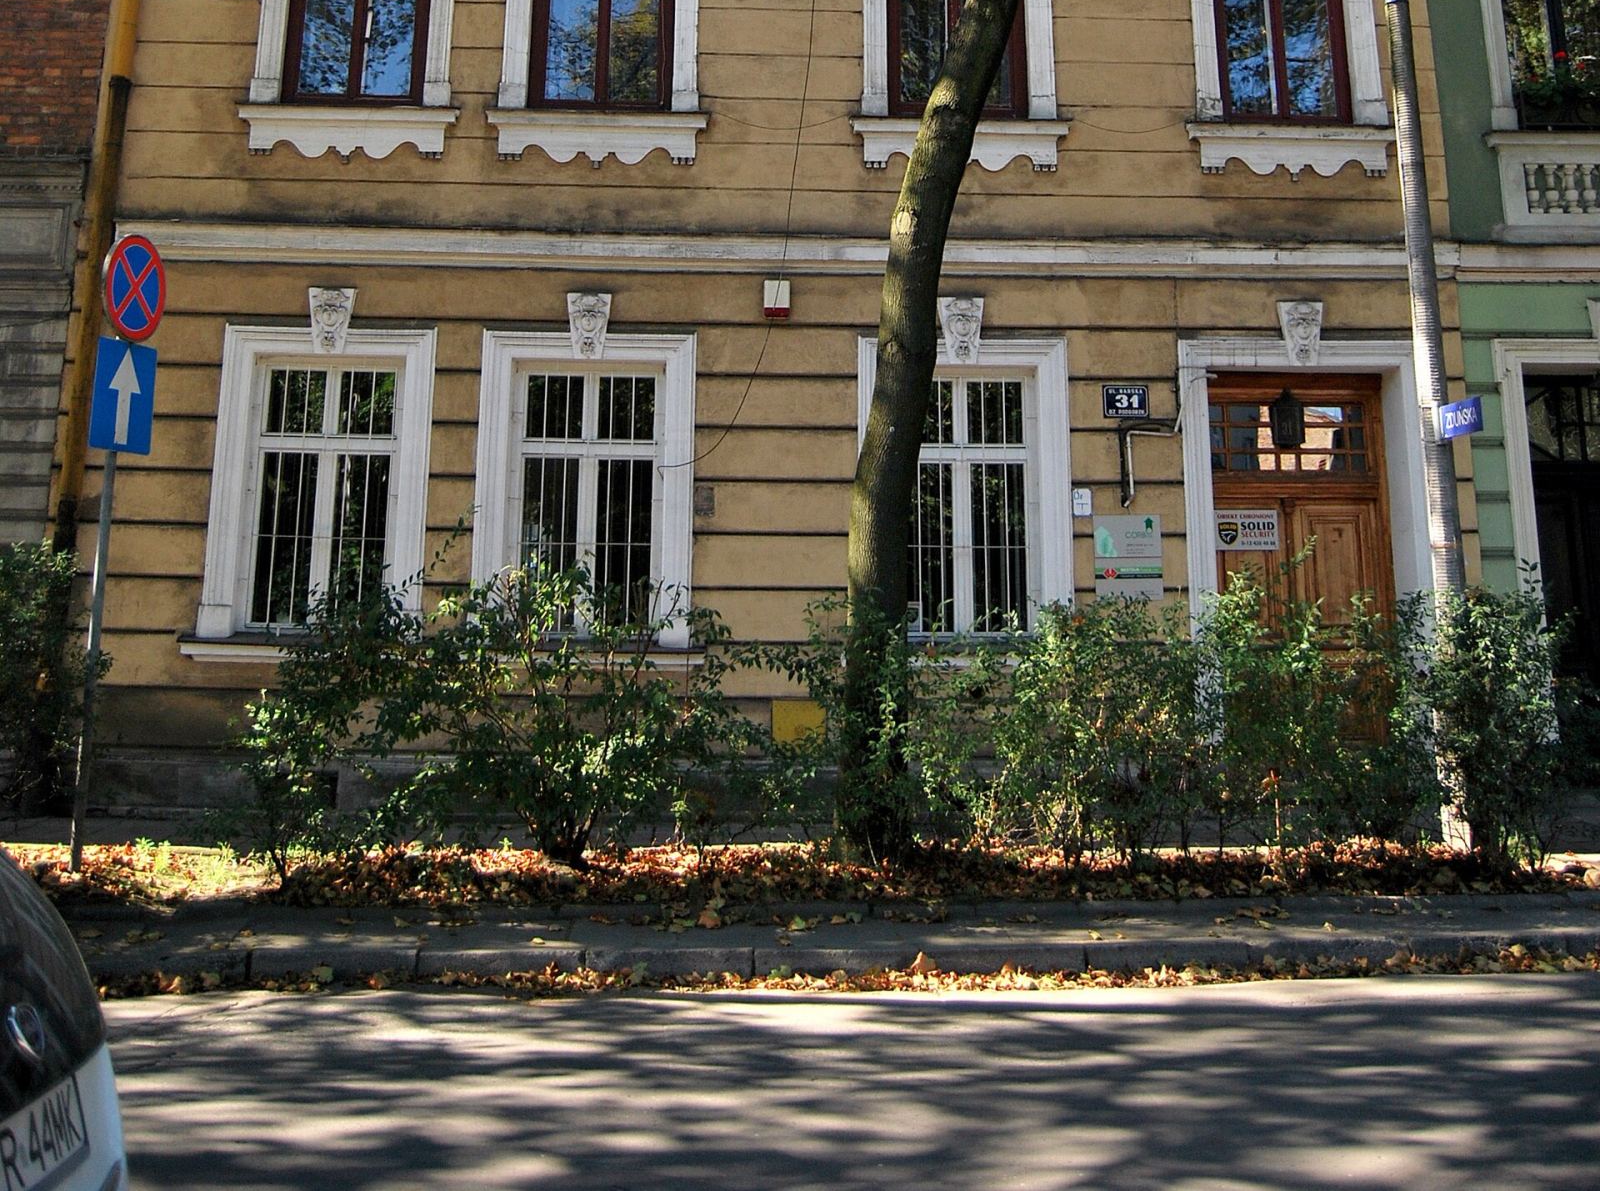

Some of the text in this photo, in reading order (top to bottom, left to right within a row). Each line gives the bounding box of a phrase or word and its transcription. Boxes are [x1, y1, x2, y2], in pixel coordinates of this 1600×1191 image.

[1115, 394, 1139, 408] 31
[1445, 405, 1478, 429] ZDUŃSKA
[1240, 521, 1275, 531] SOLID
[29, 1083, 82, 1173] 44MK
